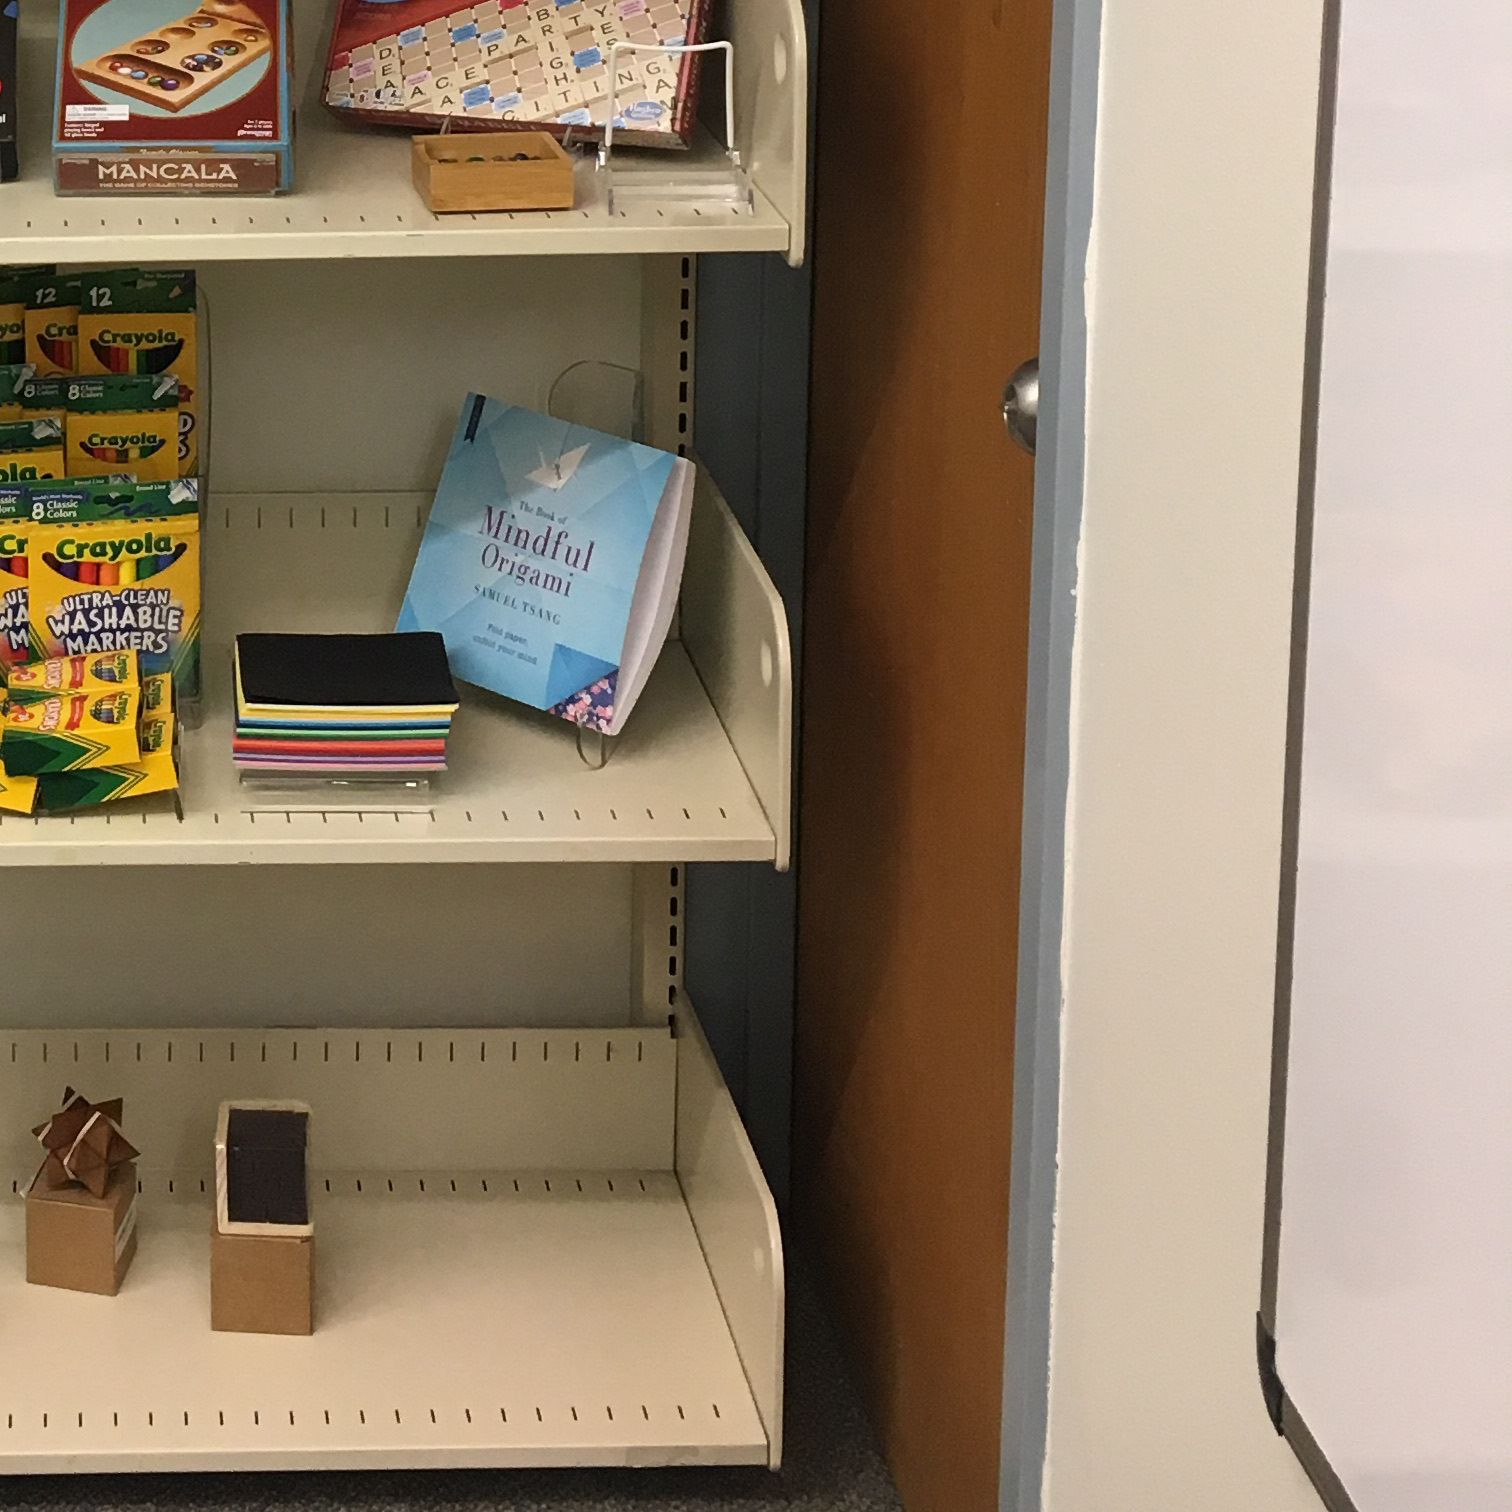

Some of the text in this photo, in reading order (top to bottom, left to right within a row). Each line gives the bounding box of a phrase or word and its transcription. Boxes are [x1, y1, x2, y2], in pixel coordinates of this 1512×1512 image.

[98, 163, 237, 180] MANCALA
[36, 287, 57, 304] 12
[89, 286, 113, 307] 12
[98, 330, 177, 347] Crayola
[24, 384, 36, 398] 8
[68, 384, 80, 400] 8
[88, 432, 158, 448] Crayola
[32, 503, 45, 520] 8
[47, 500, 79, 510] Classic
[47, 509, 78, 518] Colors
[520, 500, 534, 513] The
[478, 504, 595, 572] Mindful
[56, 532, 173, 562] Crayola
[481, 542, 574, 598] Origami
[63, 589, 168, 612] ULTRA-CLEAN
[474, 584, 562, 626] SAMUEL TSANG
[47, 606, 182, 637] WASHABLE
[66, 632, 168, 656] MARKERS
